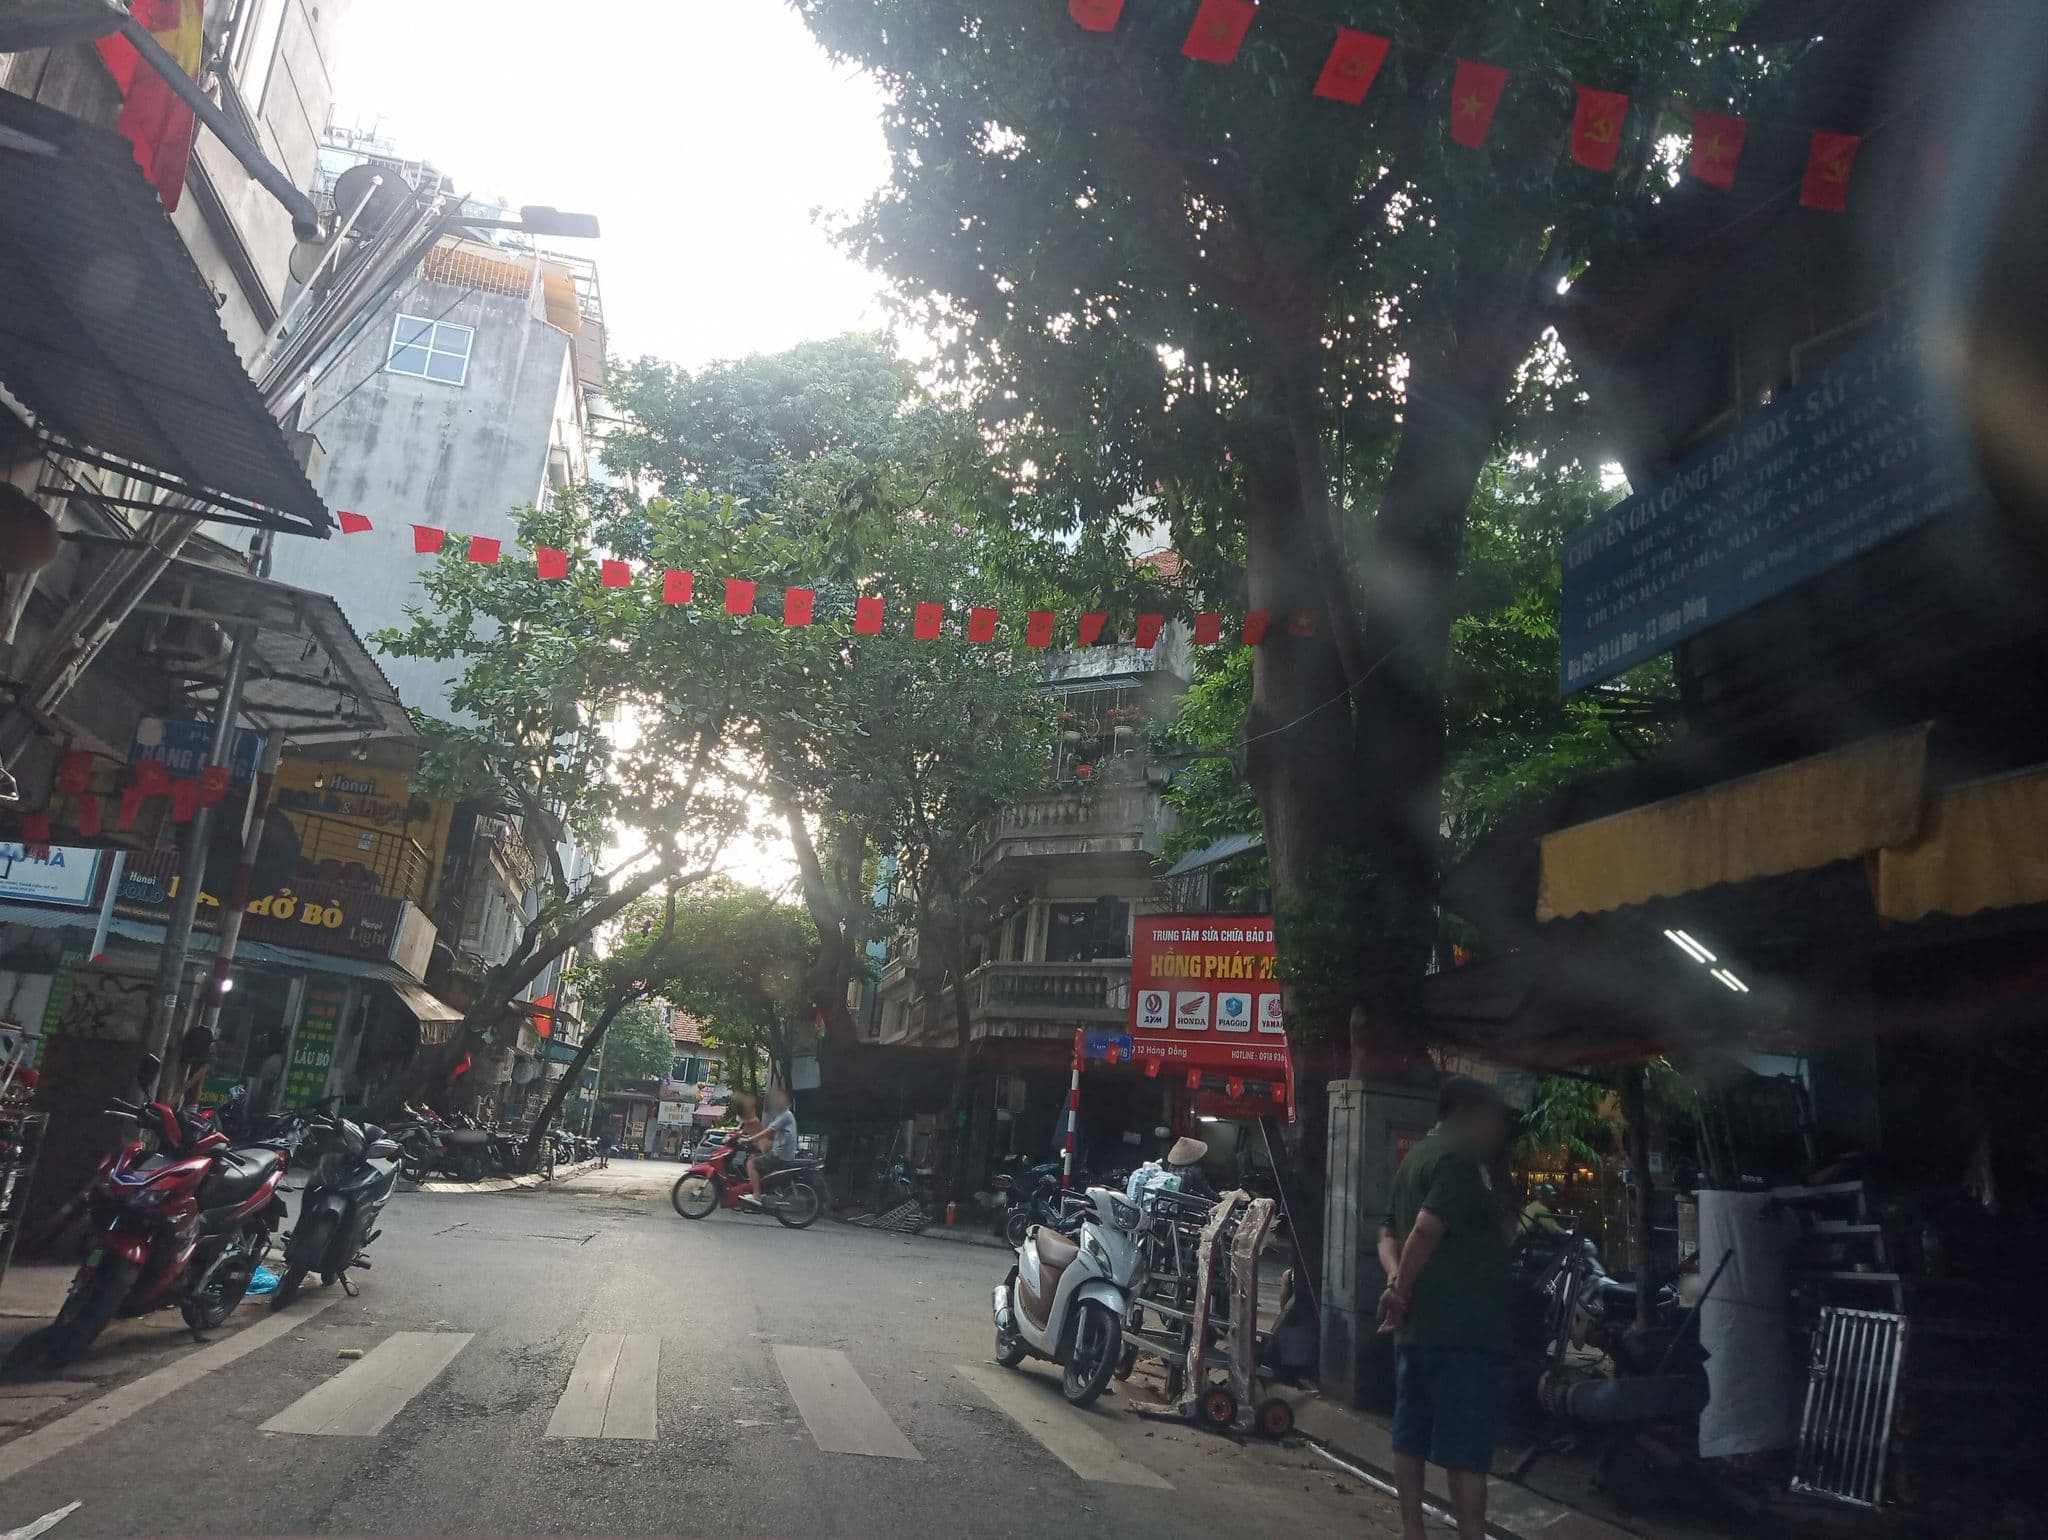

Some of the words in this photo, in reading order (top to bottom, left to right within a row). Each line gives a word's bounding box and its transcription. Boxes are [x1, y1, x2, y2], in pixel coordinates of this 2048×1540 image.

[1629, 497, 1657, 532] GIA
[1660, 471, 1709, 512] CÔNG
[1743, 409, 1791, 461] INOX
[331, 775, 377, 797] Hanoi
[299, 899, 344, 929] BÒ
[1153, 930, 1179, 942] TRUNG
[1181, 928, 1200, 942] TÂM
[1202, 926, 1219, 942] SỬA
[1221, 928, 1244, 942] CHỮA
[1246, 927, 1264, 943] BẢO
[1151, 947, 1201, 977] HỒNG
[1205, 950, 1254, 979] PHÁT
[1144, 1015, 1162, 1024] SYM
[1177, 1017, 1206, 1026] HONDA
[1218, 1018, 1248, 1027] PIAGGIO
[295, 1043, 315, 1065] LẨU
[315, 1050, 330, 1067] BÒ
[1137, 1045, 1145, 1054] 12
[1146, 1046, 1166, 1058] Hàng
[1167, 1045, 1187, 1058] Đồng
